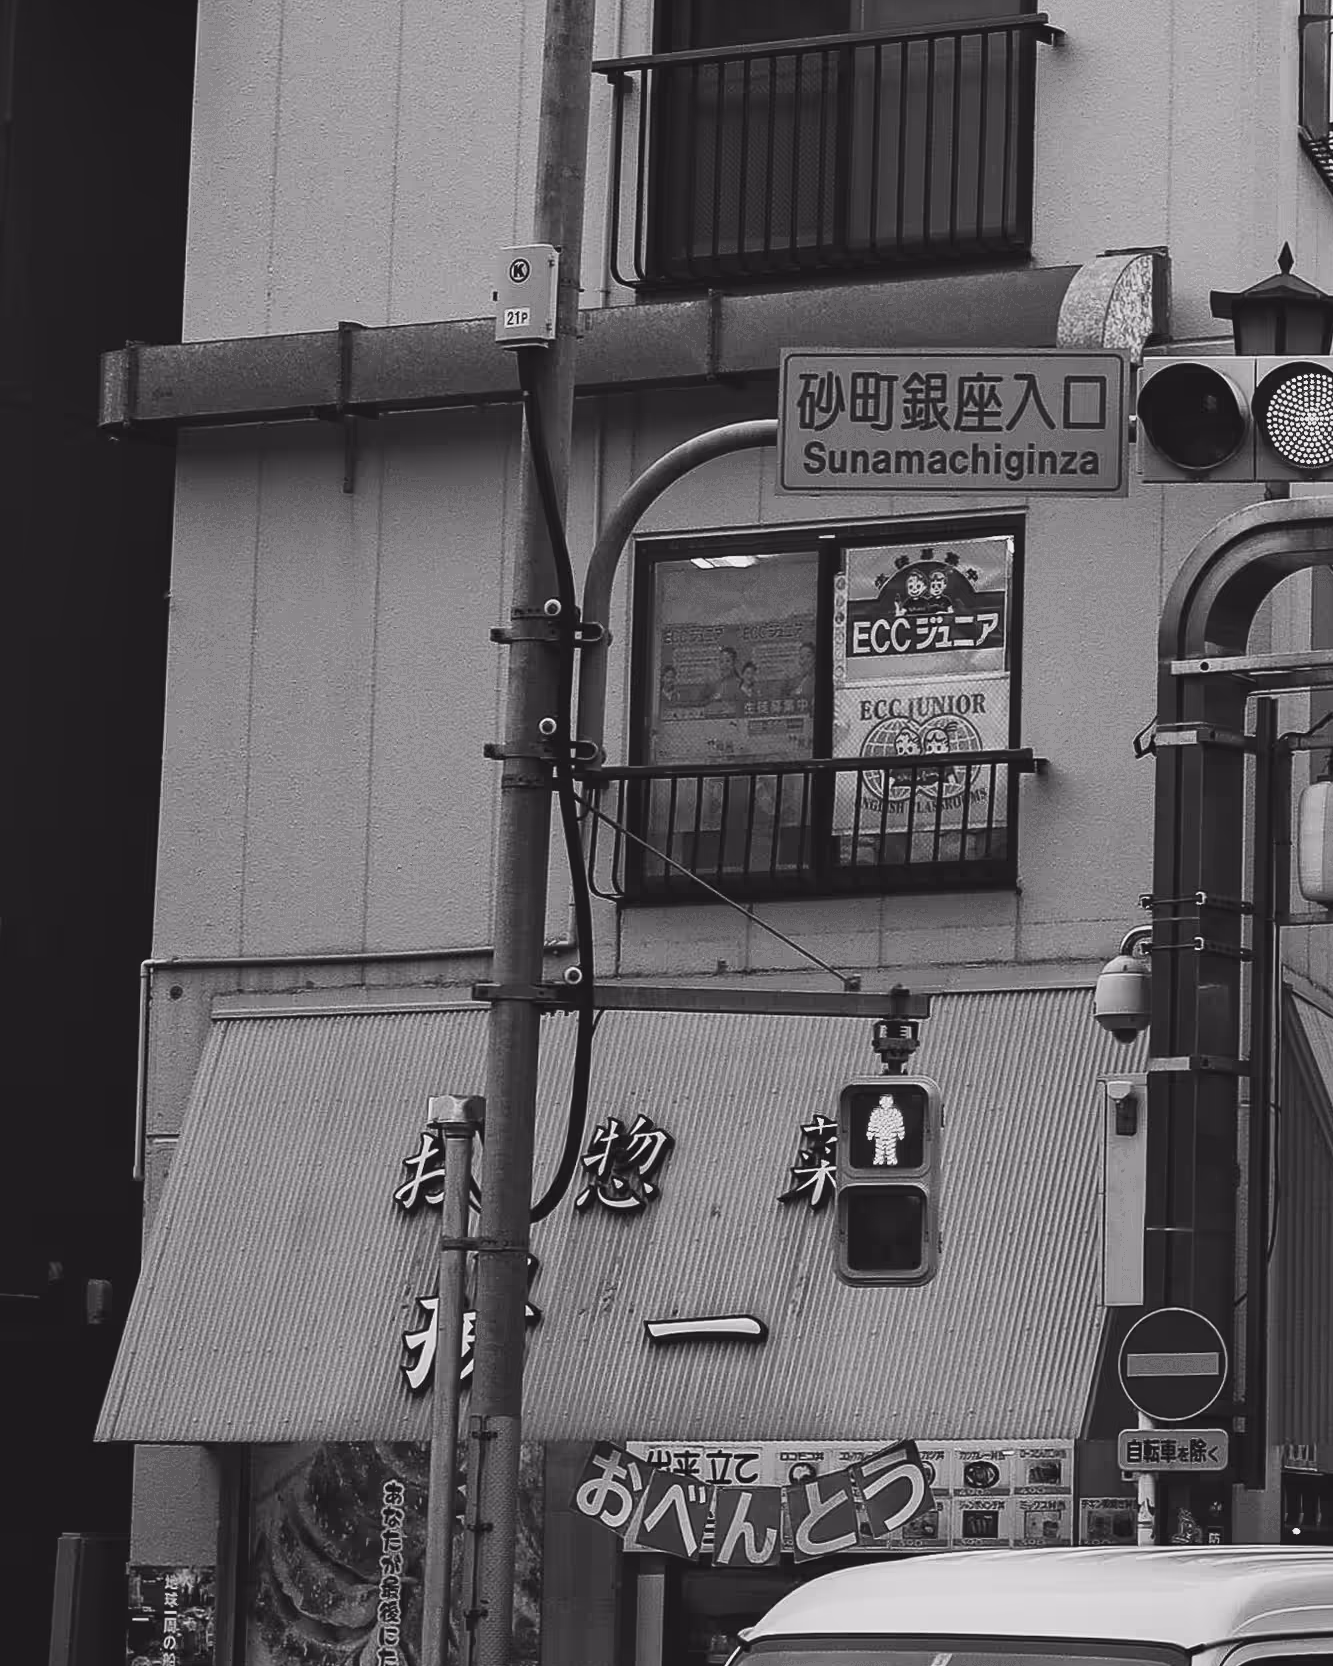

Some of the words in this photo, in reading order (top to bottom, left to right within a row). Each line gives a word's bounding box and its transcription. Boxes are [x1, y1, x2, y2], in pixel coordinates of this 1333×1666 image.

[798, 371, 1108, 433] 砂町銀座入口
[803, 440, 1100, 482] Sunamachiginza
[852, 612, 999, 654] ECCジュニア
[859, 698, 903, 721] ECC
[908, 693, 987, 720] JUNIOR
[1126, 1437, 1219, 1464] 自転車を除く
[575, 1447, 927, 1566] おべんとう
